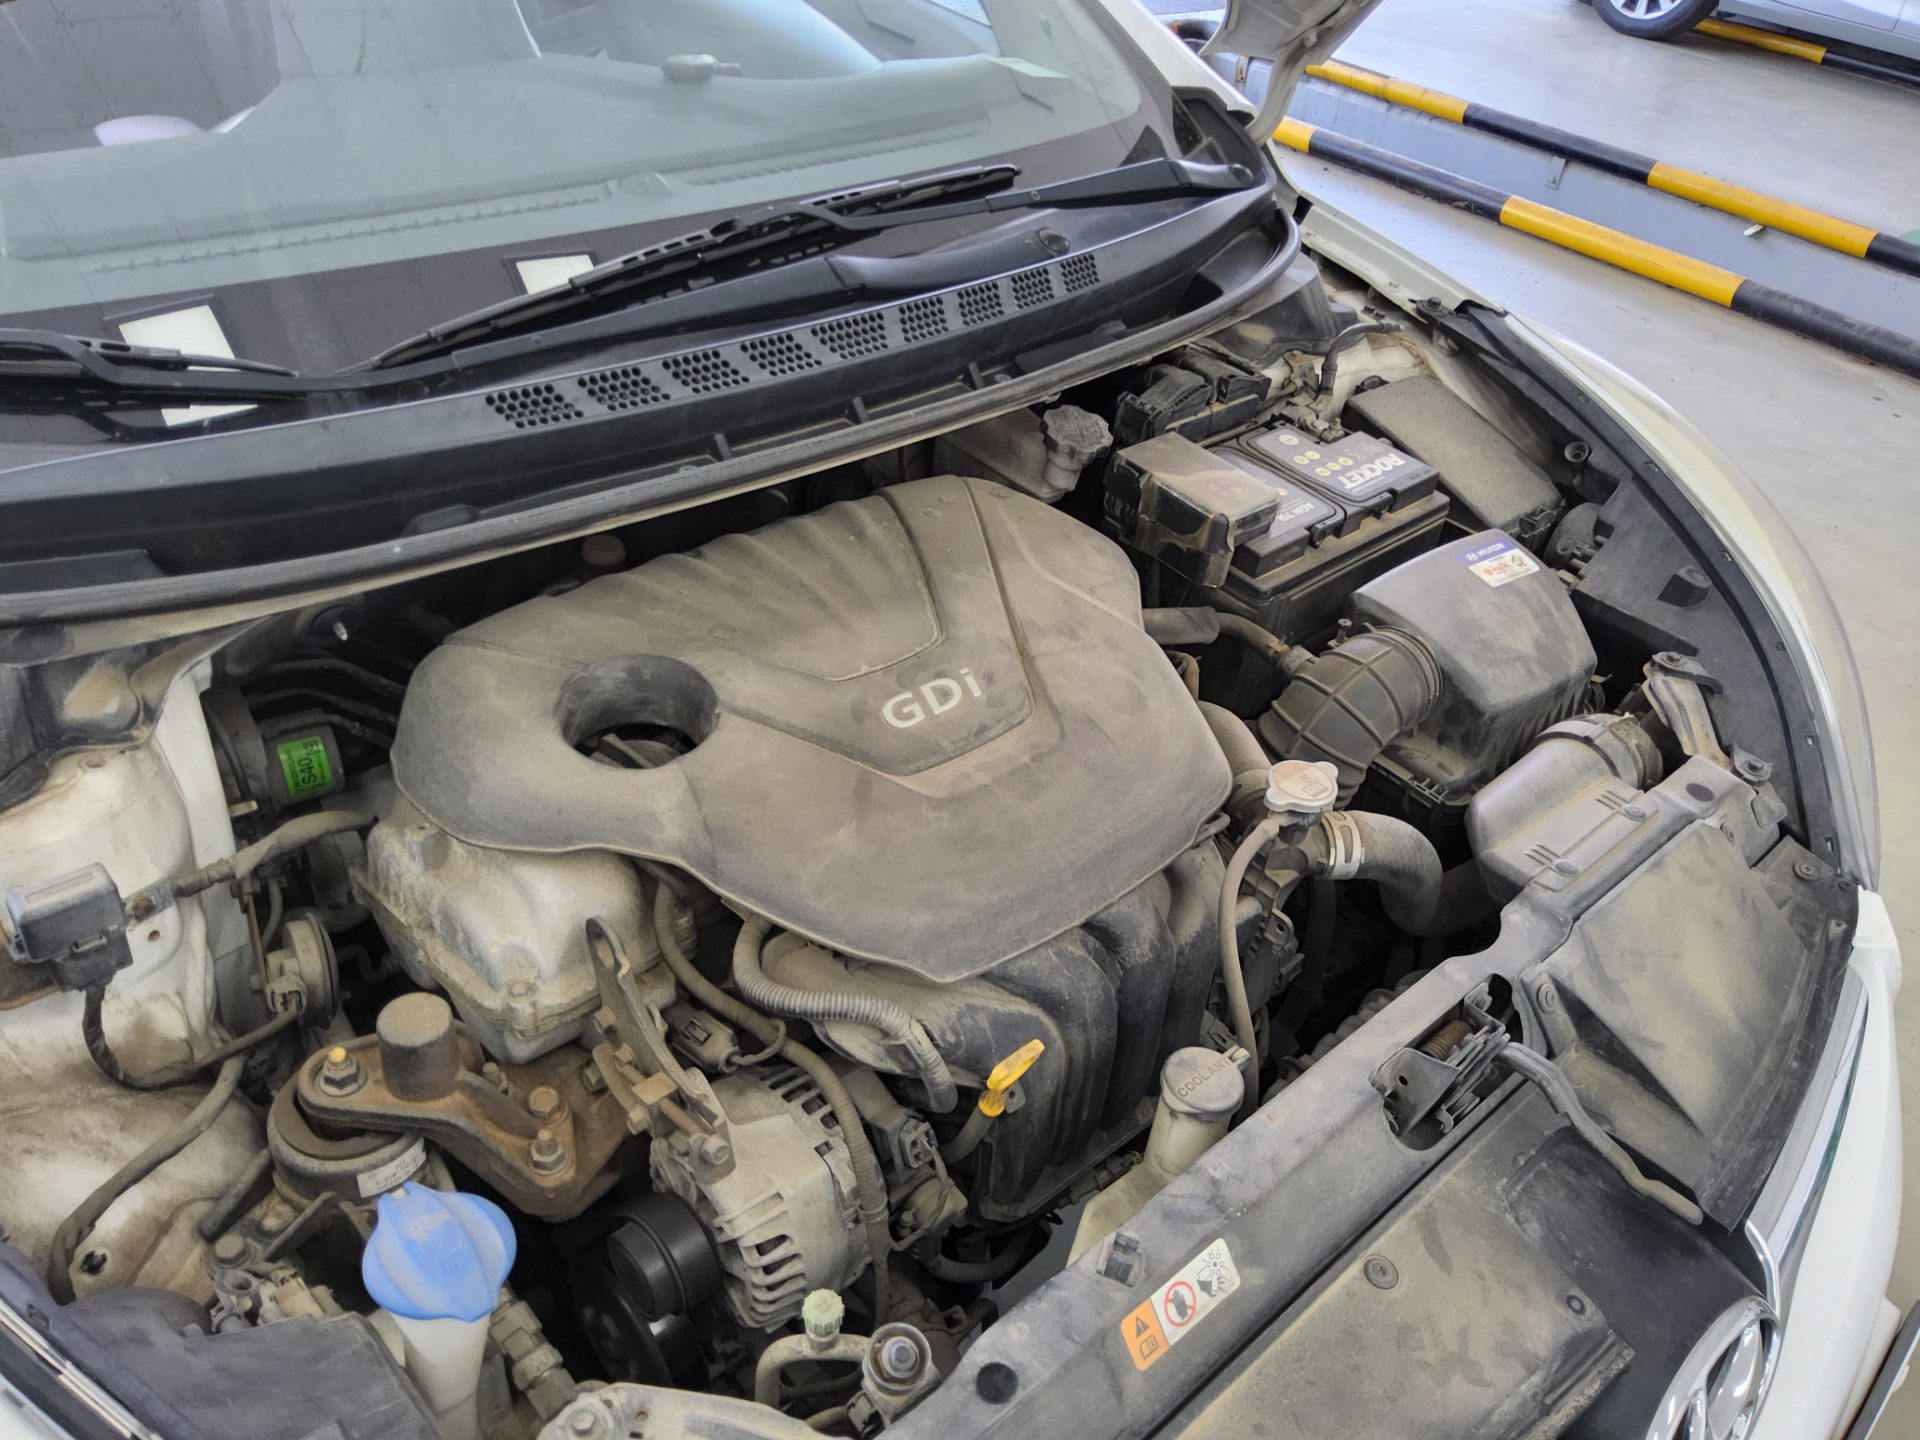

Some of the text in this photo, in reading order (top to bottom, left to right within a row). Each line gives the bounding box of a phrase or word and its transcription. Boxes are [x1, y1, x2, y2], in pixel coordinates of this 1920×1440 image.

[1338, 453, 1406, 490] ROCKET
[882, 667, 982, 728] GDi
[1177, 1060, 1232, 1098] COOLANT
